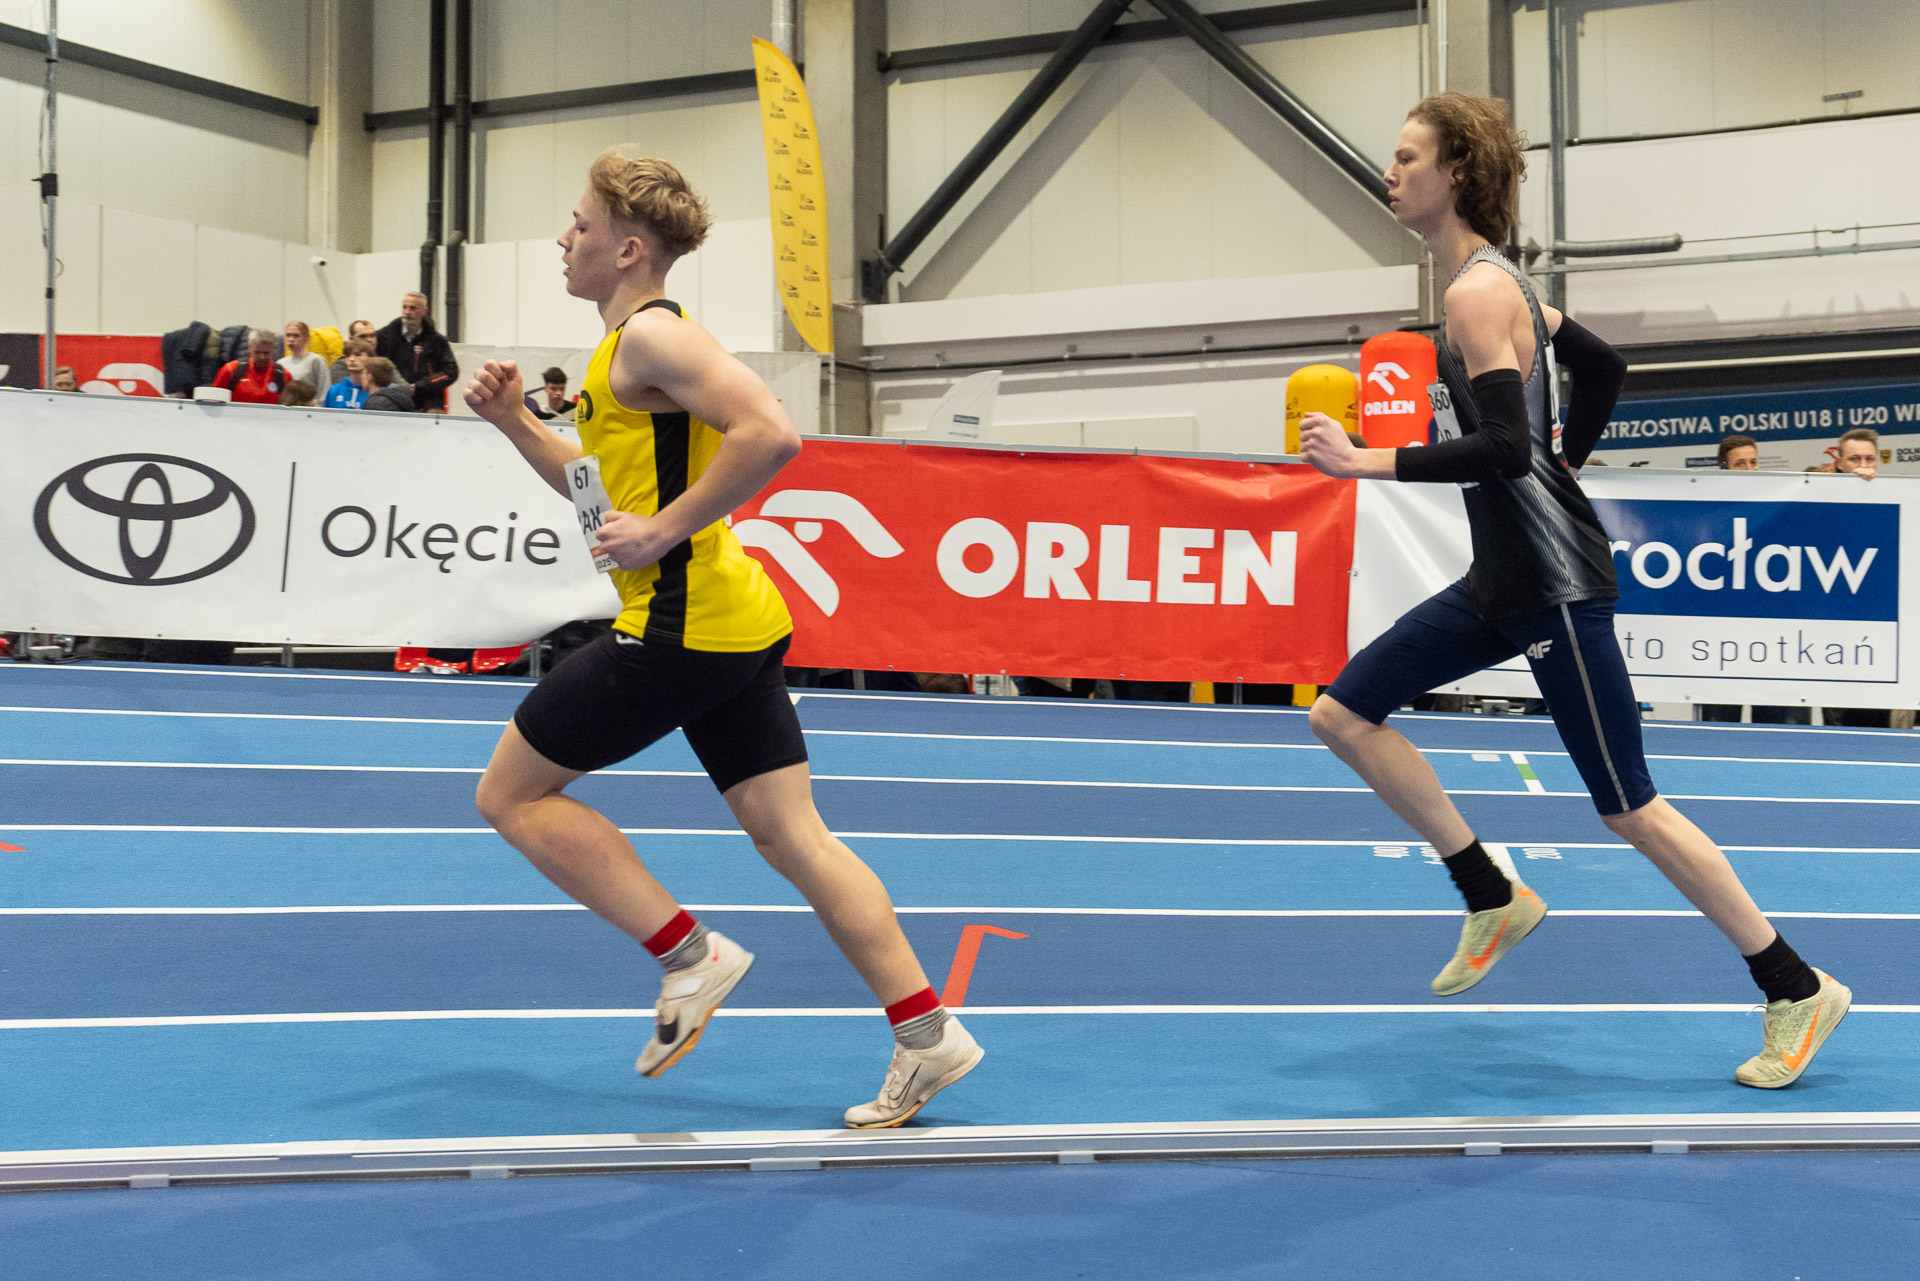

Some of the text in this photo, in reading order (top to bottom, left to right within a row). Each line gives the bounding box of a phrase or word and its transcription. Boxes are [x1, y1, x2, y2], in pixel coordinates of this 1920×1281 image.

[1364, 400, 1416, 416] ORLEN
[1719, 411, 1789, 432] POLSKI
[1794, 409, 1833, 429] U18
[1837, 409, 1844, 426] i
[1850, 406, 1889, 426] U20
[574, 465, 589, 490] 67
[578, 505, 603, 535] AK
[321, 504, 560, 574] Okęcie
[936, 517, 1298, 606] ORLEN
[1526, 639, 1553, 659] 4F
[1623, 629, 1874, 671] to spotkań
